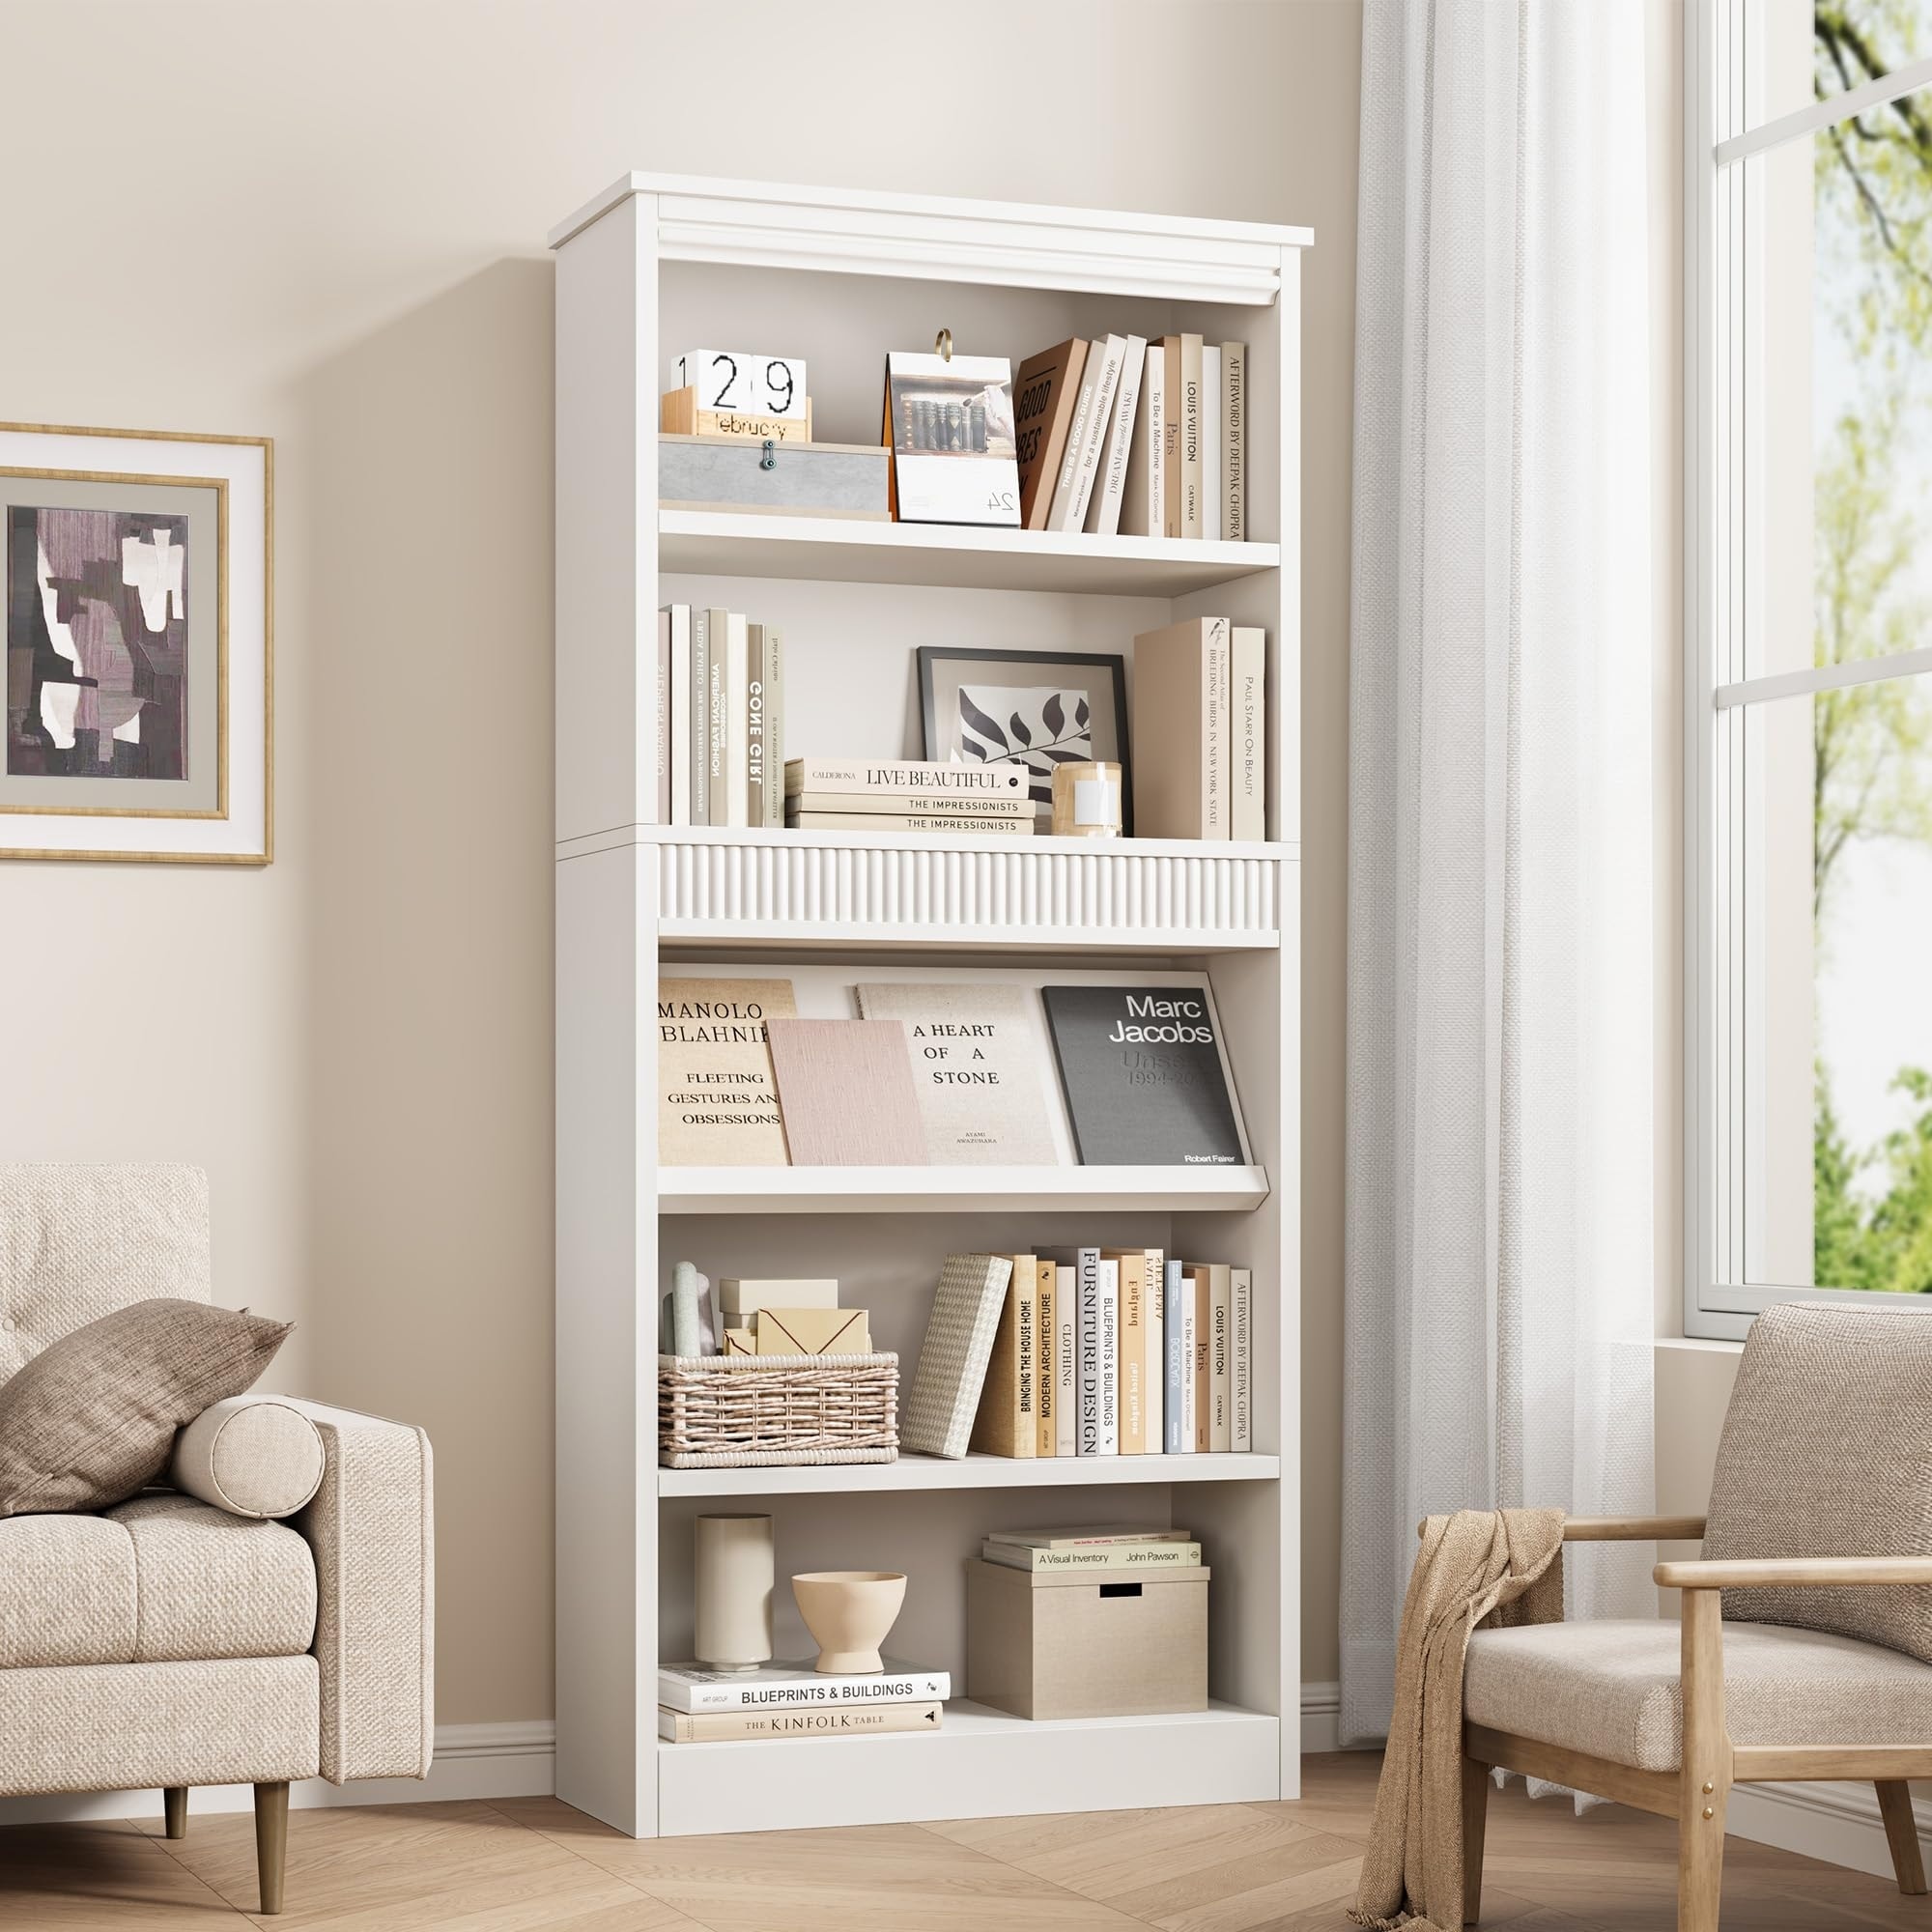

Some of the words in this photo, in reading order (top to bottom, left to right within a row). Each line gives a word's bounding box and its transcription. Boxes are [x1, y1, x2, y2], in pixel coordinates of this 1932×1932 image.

[1017, 380, 1052, 423] GOOD
[1153, 391, 1160, 402] To
[1187, 382, 1197, 414] LOUIS
[1230, 356, 1240, 428] AFTERWORD
[1084, 455, 1093, 469] for
[1091, 396, 1107, 446] sustainable
[1101, 358, 1117, 394] lifestyle
[1153, 405, 1160, 418] Be
[1063, 467, 1073, 488] THIS
[1068, 456, 1075, 467] IS
[1072, 416, 1085, 446] GOOD
[1080, 384, 1093, 415] GUIDE
[1109, 457, 1122, 495] DREAM
[1121, 390, 1133, 425] AWAKE
[1166, 423, 1178, 456] Paris
[1187, 416, 1196, 463] VUITTON
[1230, 430, 1239, 445] BY
[1230, 447, 1239, 491] DEEPAK
[1230, 494, 1239, 539] CHOPRA
[1245, 676, 1254, 702] PAUL
[1245, 706, 1254, 736] STARR
[1209, 732, 1216, 742] IN
[1245, 739, 1253, 756] ON
[812, 772, 856, 781] CALDERONA
[867, 770, 905, 786] LIVE
[909, 770, 1001, 789] BEAUTIFUL
[909, 800, 928, 810] THE
[932, 801, 1019, 811] IMPRESSIONISTS
[907, 819, 925, 828] THE
[930, 819, 1017, 831] IMPRESSIONISTS
[658, 1002, 762, 1019] MANOLO
[1124, 995, 1202, 1018] Marc
[913, 1025, 925, 1037] A
[931, 1024, 996, 1037] HEART
[1108, 1020, 1213, 1043] Jacobs
[923, 1047, 949, 1059] OF
[972, 1048, 985, 1060] A
[687, 1073, 764, 1084] FLEETING
[933, 1072, 1000, 1085] STONE
[668, 1094, 751, 1104] GESTURES
[754, 1094, 781, 1104] AN
[682, 1114, 781, 1124] OBSESSIONS
[1184, 1154, 1212, 1163] Robert
[1212, 1154, 1236, 1163] Fairer
[1020, 1300, 1031, 1323] HOME
[1084, 1252, 1096, 1373] FURNITURE
[1185, 1318, 1192, 1327] To
[1237, 1283, 1246, 1344] AFTERWORD
[1020, 1326, 1031, 1352] HOUSE
[1041, 1293, 1051, 1372] ARCHITECTURE
[1104, 1297, 1113, 1360] BLUEPRINTS
[1185, 1328, 1192, 1340] Be
[1020, 1355, 1031, 1370] THE
[1063, 1323, 1072, 1387] CLOTHING
[1198, 1342, 1208, 1372] Paris
[1237, 1347, 1246, 1359] BY
[1237, 1361, 1246, 1399] DEEPAK
[1020, 1373, 1031, 1412] BRINGING
[1041, 1375, 1050, 1418] MODERN
[1104, 1373, 1113, 1427] BUILDINGS
[1084, 1378, 1096, 1454] DESIGN
[1237, 1401, 1246, 1440] CHOPRA
[1038, 1555, 1047, 1564] A
[1047, 1554, 1071, 1564] Visual
[1072, 1553, 1109, 1564] Inventory
[1126, 1552, 1146, 1562] John
[1148, 1551, 1179, 1561] Pawson
[741, 1688, 824, 1704] BLUEPRINTS
[829, 1688, 838, 1698] &
[842, 1683, 913, 1697] BUILDINGS
[746, 1721, 766, 1730] THE
[771, 1715, 851, 1731] KINFOLK
[854, 1716, 885, 1724] TABLE
